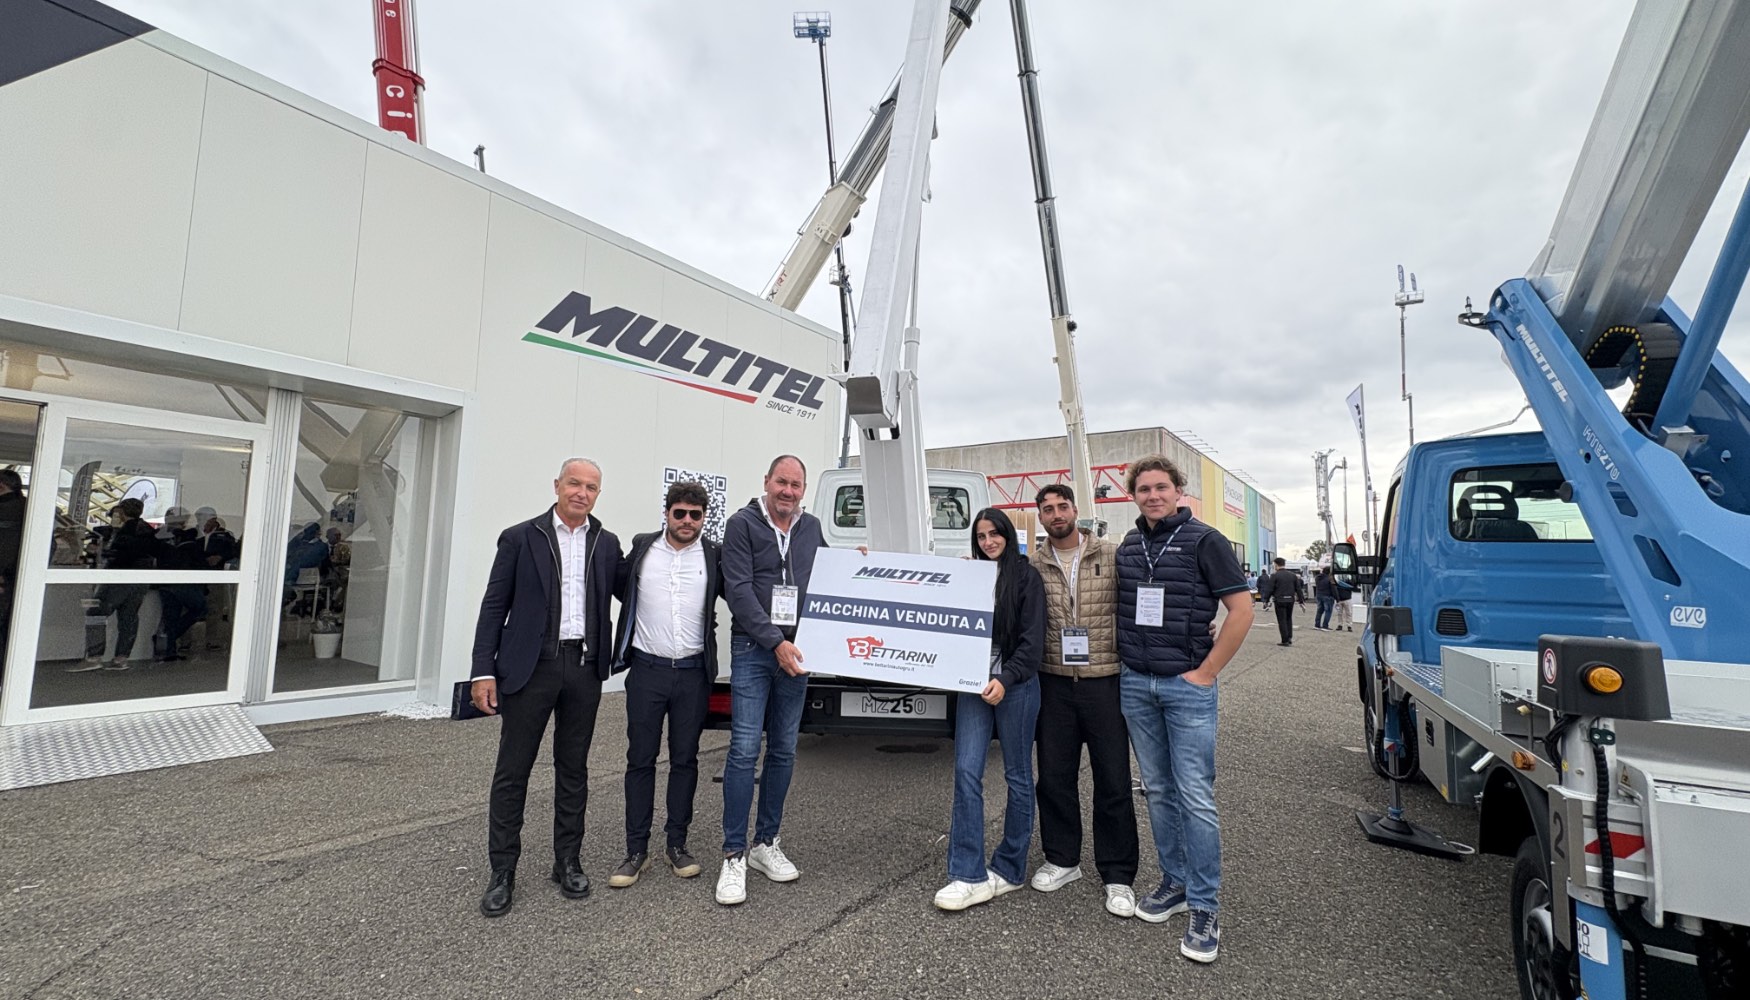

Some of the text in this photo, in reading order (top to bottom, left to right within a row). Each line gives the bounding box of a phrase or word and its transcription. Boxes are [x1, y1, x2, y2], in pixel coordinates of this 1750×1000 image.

[534, 290, 826, 410] MULTITEL
[1515, 323, 1569, 403] MULTITEL
[765, 400, 817, 421] SINCE 1911
[855, 566, 952, 584] MULTITEL
[808, 600, 890, 621] MACCHINA
[895, 609, 970, 629] VENDUTA
[974, 617, 987, 631] A
[1673, 607, 1705, 624] eve
[850, 640, 938, 665] BETTARINI
[958, 678, 982, 687] Grazie!
[861, 695, 927, 715] MZ250
[1552, 811, 1566, 860] 2
